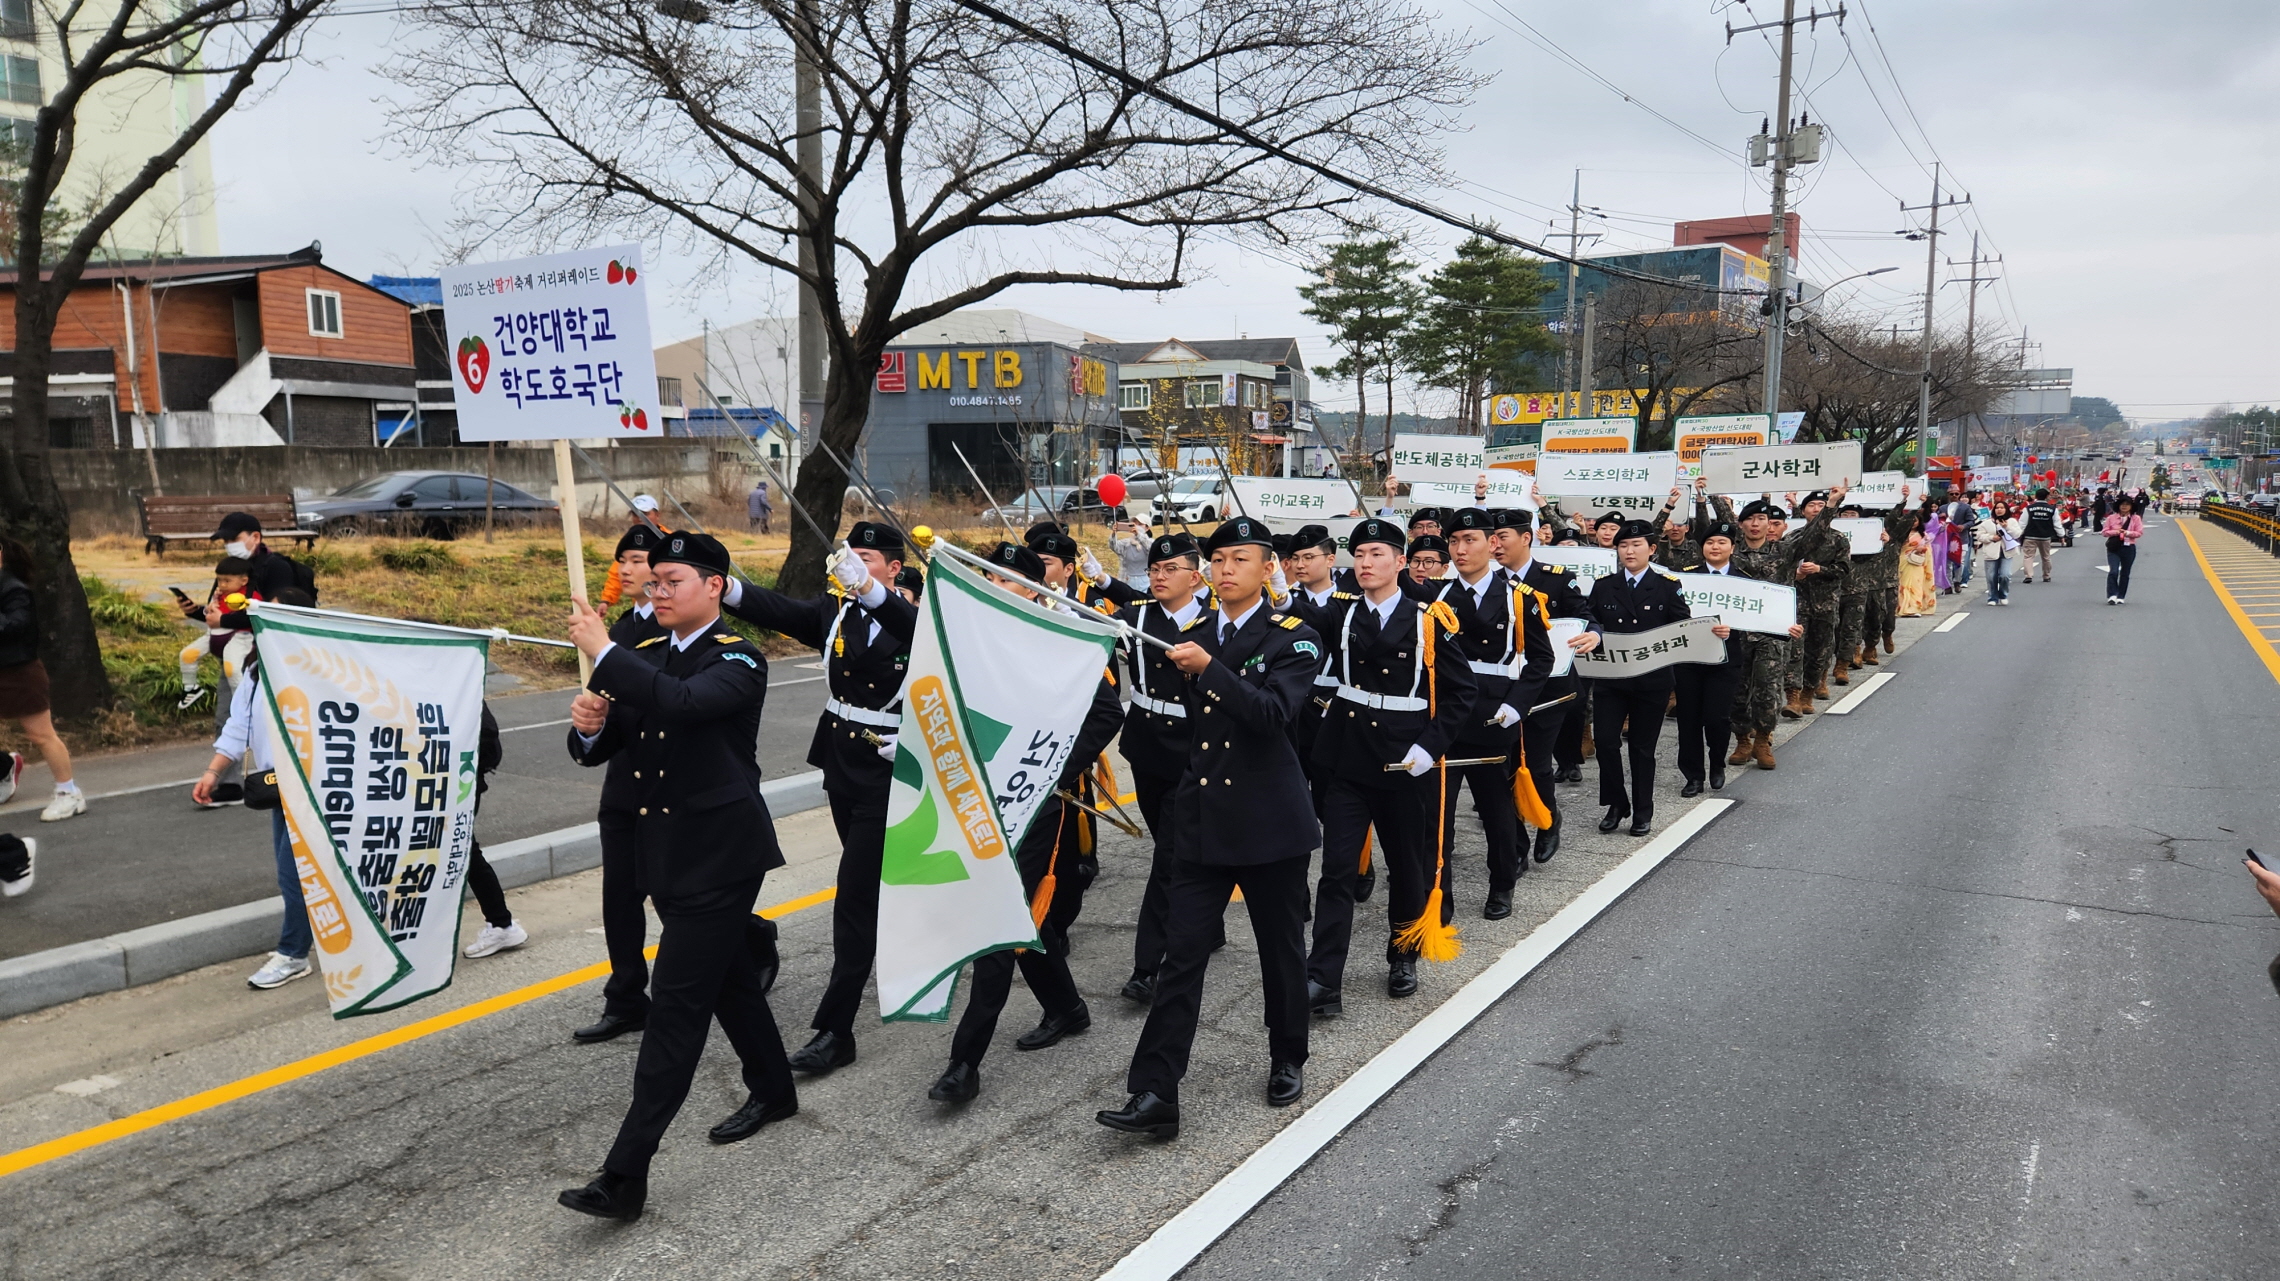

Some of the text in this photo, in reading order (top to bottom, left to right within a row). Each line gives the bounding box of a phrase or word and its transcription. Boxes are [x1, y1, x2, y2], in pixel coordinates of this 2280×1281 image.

[453, 267, 601, 298] 2025 논산딸기축제 거리퍼레이드
[493, 306, 617, 357] 건양대학교
[467, 353, 482, 385] 6
[917, 350, 1023, 390] MTB
[500, 361, 625, 410] 학도호국단
[1394, 450, 1484, 469] 반도체공학과
[1563, 467, 1650, 482] 스포츠의학과
[1741, 458, 1821, 479] 군사학과
[1259, 493, 1325, 510] 유아교육과
[1433, 482, 1524, 496] 스마트안학과
[920, 687, 998, 850] 지역과 함께 세계로!
